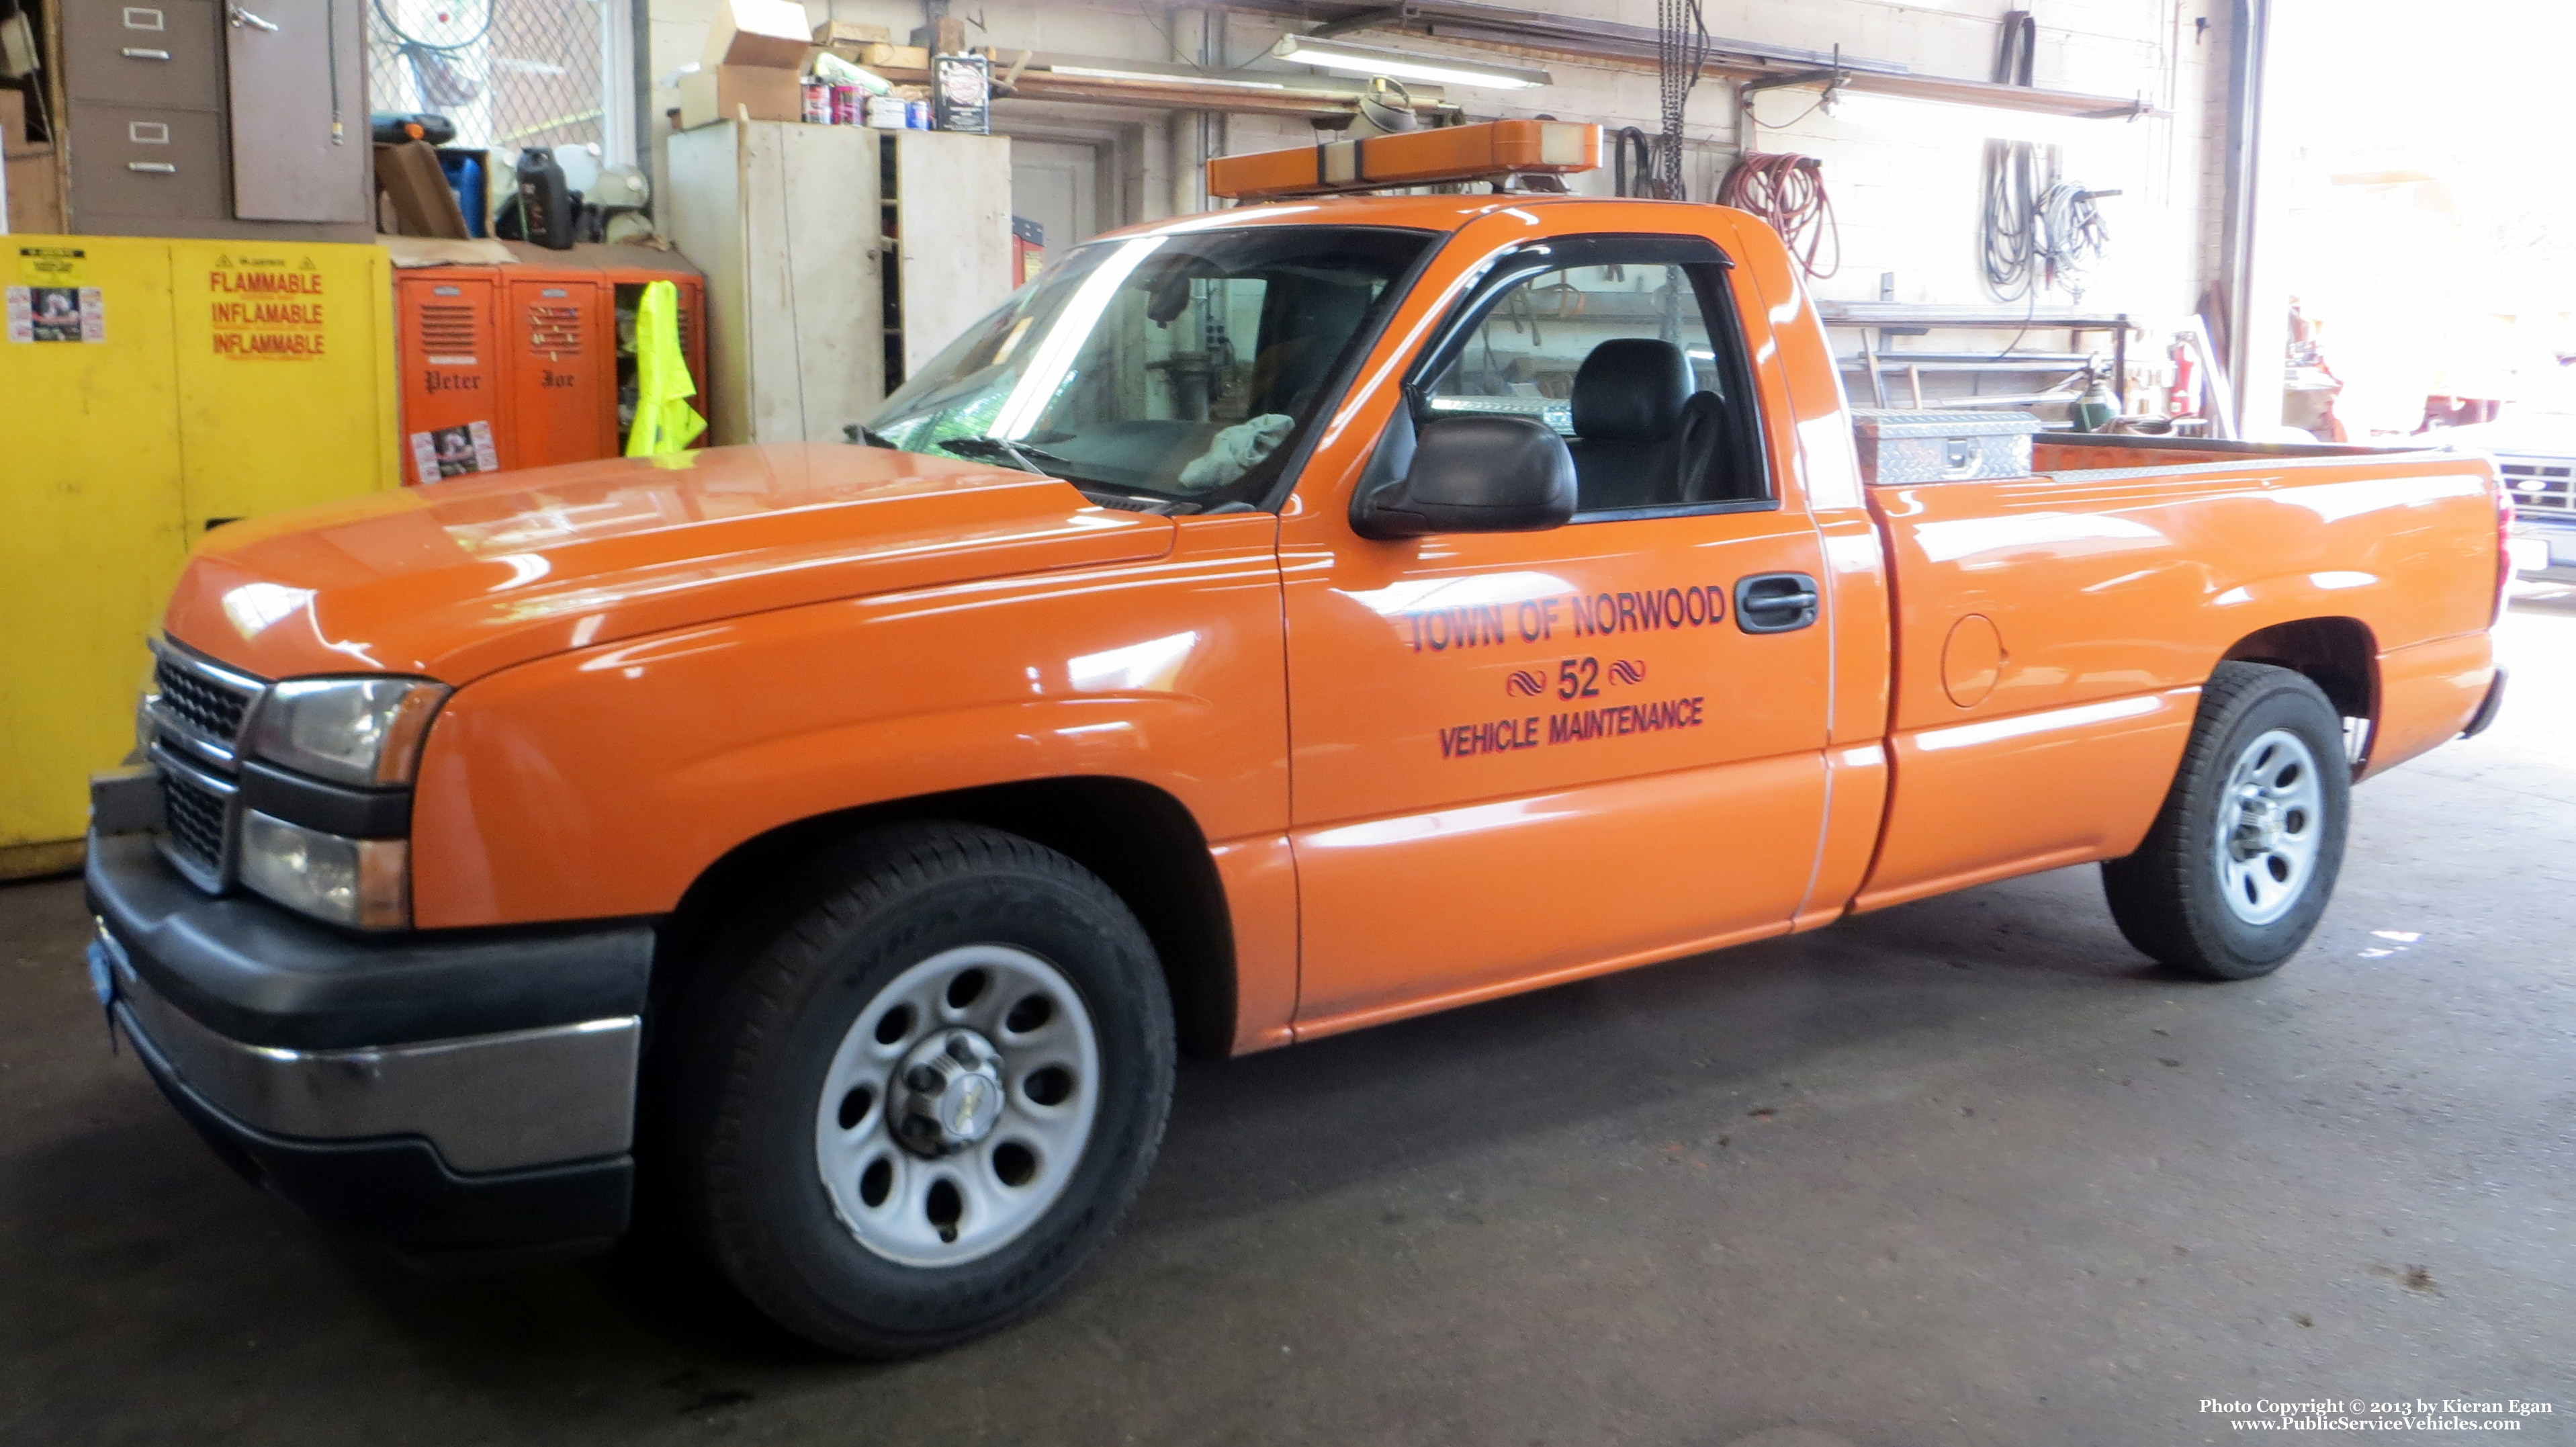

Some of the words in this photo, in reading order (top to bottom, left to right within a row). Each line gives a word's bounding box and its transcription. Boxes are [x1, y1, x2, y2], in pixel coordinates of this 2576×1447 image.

[210, 271, 322, 294] FLAMMABLE
[212, 302, 322, 324] INFLAMABLE
[212, 334, 324, 354] INFLAMMABLE
[425, 369, 481, 395] Peter
[542, 369, 575, 388] Joe
[1409, 604, 1505, 652] TOWN
[1517, 598, 1560, 643] OF
[1572, 585, 1726, 638] NORWOOD
[1557, 656, 1601, 701] 52
[1439, 716, 1541, 759] VEHICLE
[1548, 696, 1705, 745] MAINTENANCE
